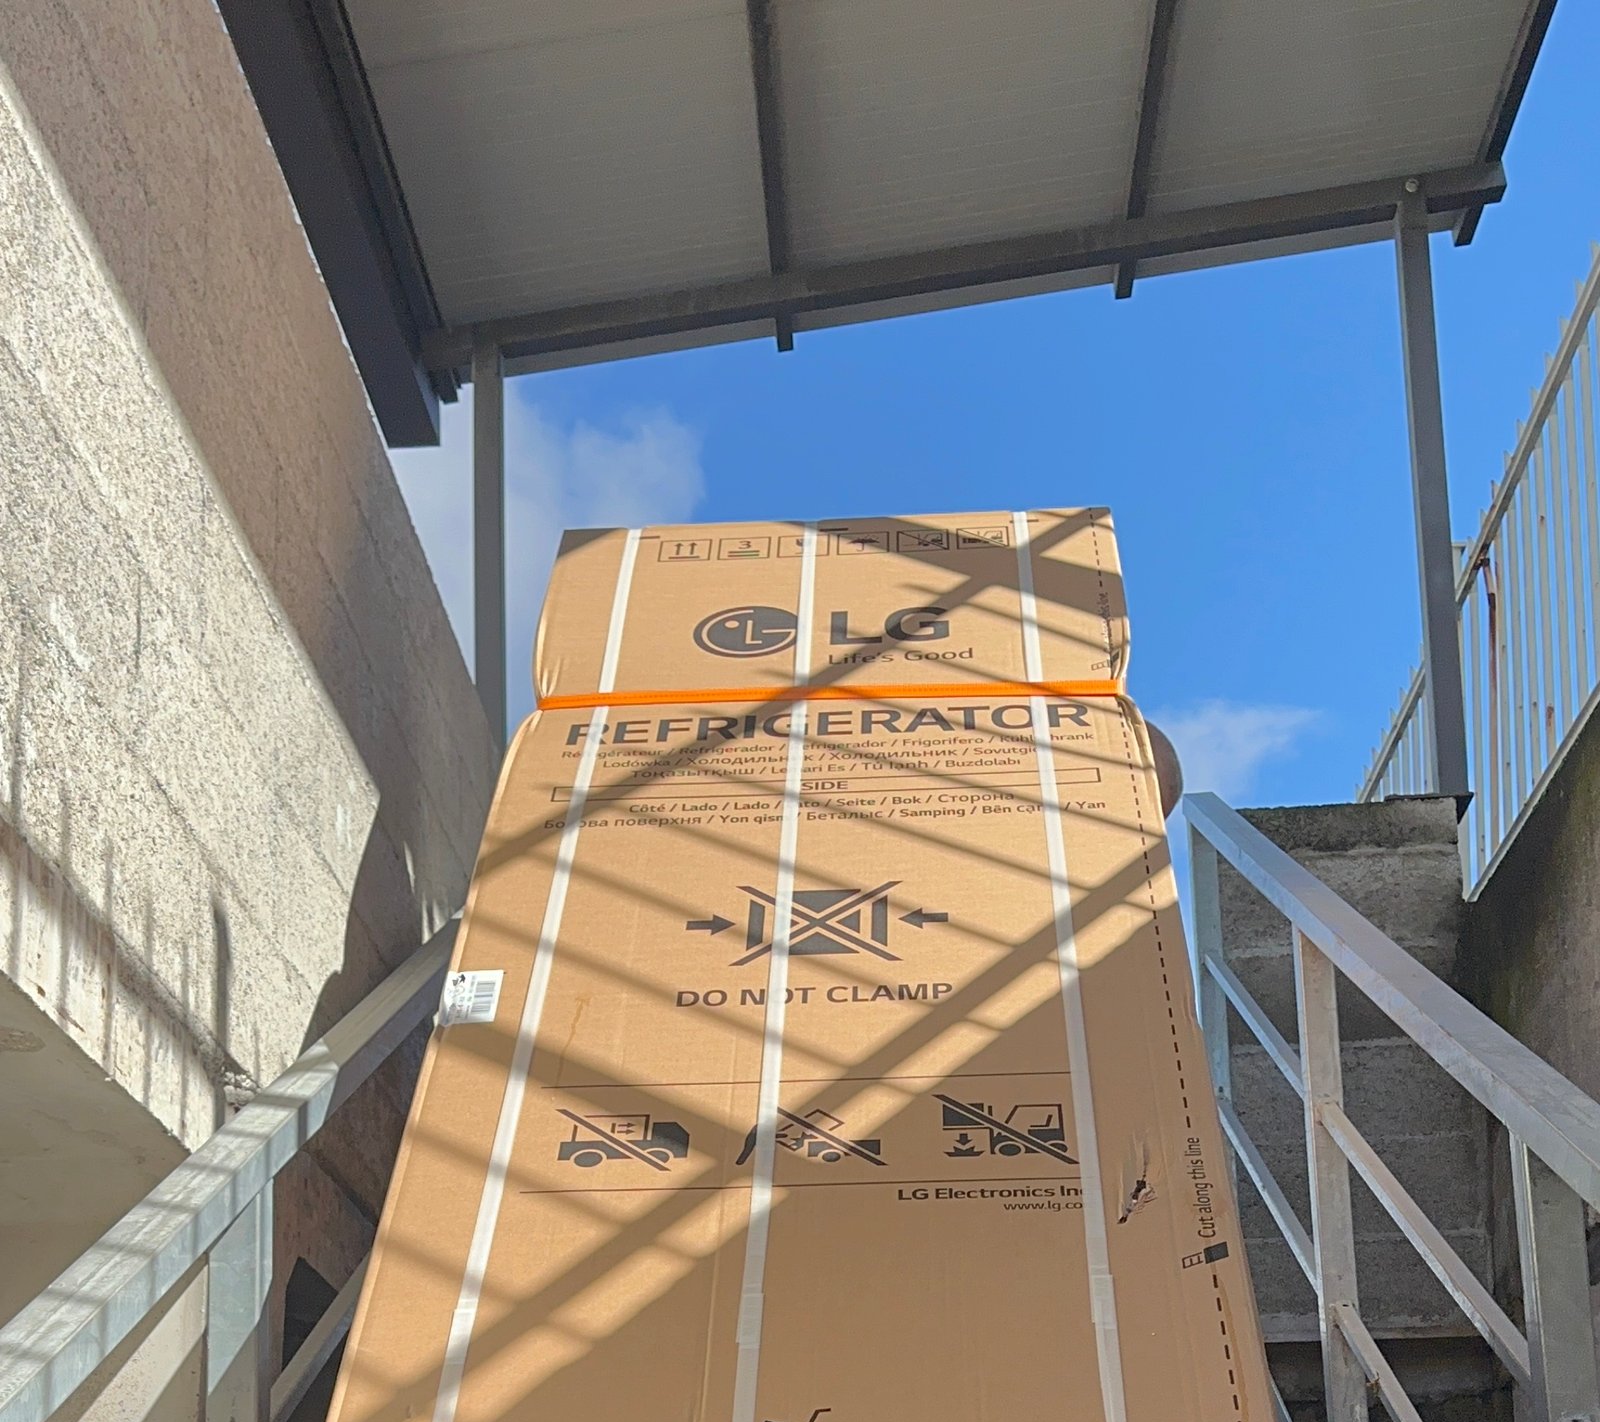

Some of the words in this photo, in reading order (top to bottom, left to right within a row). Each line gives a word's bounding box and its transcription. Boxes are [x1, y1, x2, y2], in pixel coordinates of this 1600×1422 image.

[829, 606, 950, 645] LG
[828, 651, 894, 665] Life's
[904, 647, 973, 662] Good
[566, 703, 1092, 745] REFRIGERATOR
[561, 749, 663, 759] Régérateur
[679, 744, 776, 755] Refrigerador
[802, 741, 887, 750] efrigerador
[902, 737, 984, 747] Frigorifero
[1000, 732, 1094, 743] Kühlhrank
[603, 758, 670, 768] Lodówka
[687, 754, 813, 765] Холодильнк
[829, 749, 958, 760] Холодильник
[771, 764, 823, 774] Leari
[827, 764, 845, 772] Es
[801, 780, 849, 791] SIDE
[629, 803, 666, 813] Côté
[681, 803, 718, 812] Lado
[734, 801, 770, 811] Lado
[836, 797, 876, 807] Seite
[892, 795, 922, 805] Bok
[938, 793, 1015, 804] Сторона
[544, 818, 609, 829] Боова
[614, 816, 701, 827] поверхня
[720, 814, 749, 824] Yon
[807, 811, 883, 821] Беталыс
[900, 807, 966, 818] Samping
[1075, 801, 1106, 810] Yan
[675, 989, 728, 1007] DO
[826, 982, 953, 1003] CLAMP
[1184, 1137, 1202, 1157] line
[1187, 1159, 1206, 1180] this
[898, 1188, 929, 1201] LG
[935, 1186, 1056, 1200] Electronics
[1193, 1182, 1214, 1214] along
[1003, 1200, 1084, 1212] www.lg.co
[1198, 1215, 1217, 1239] Cut
